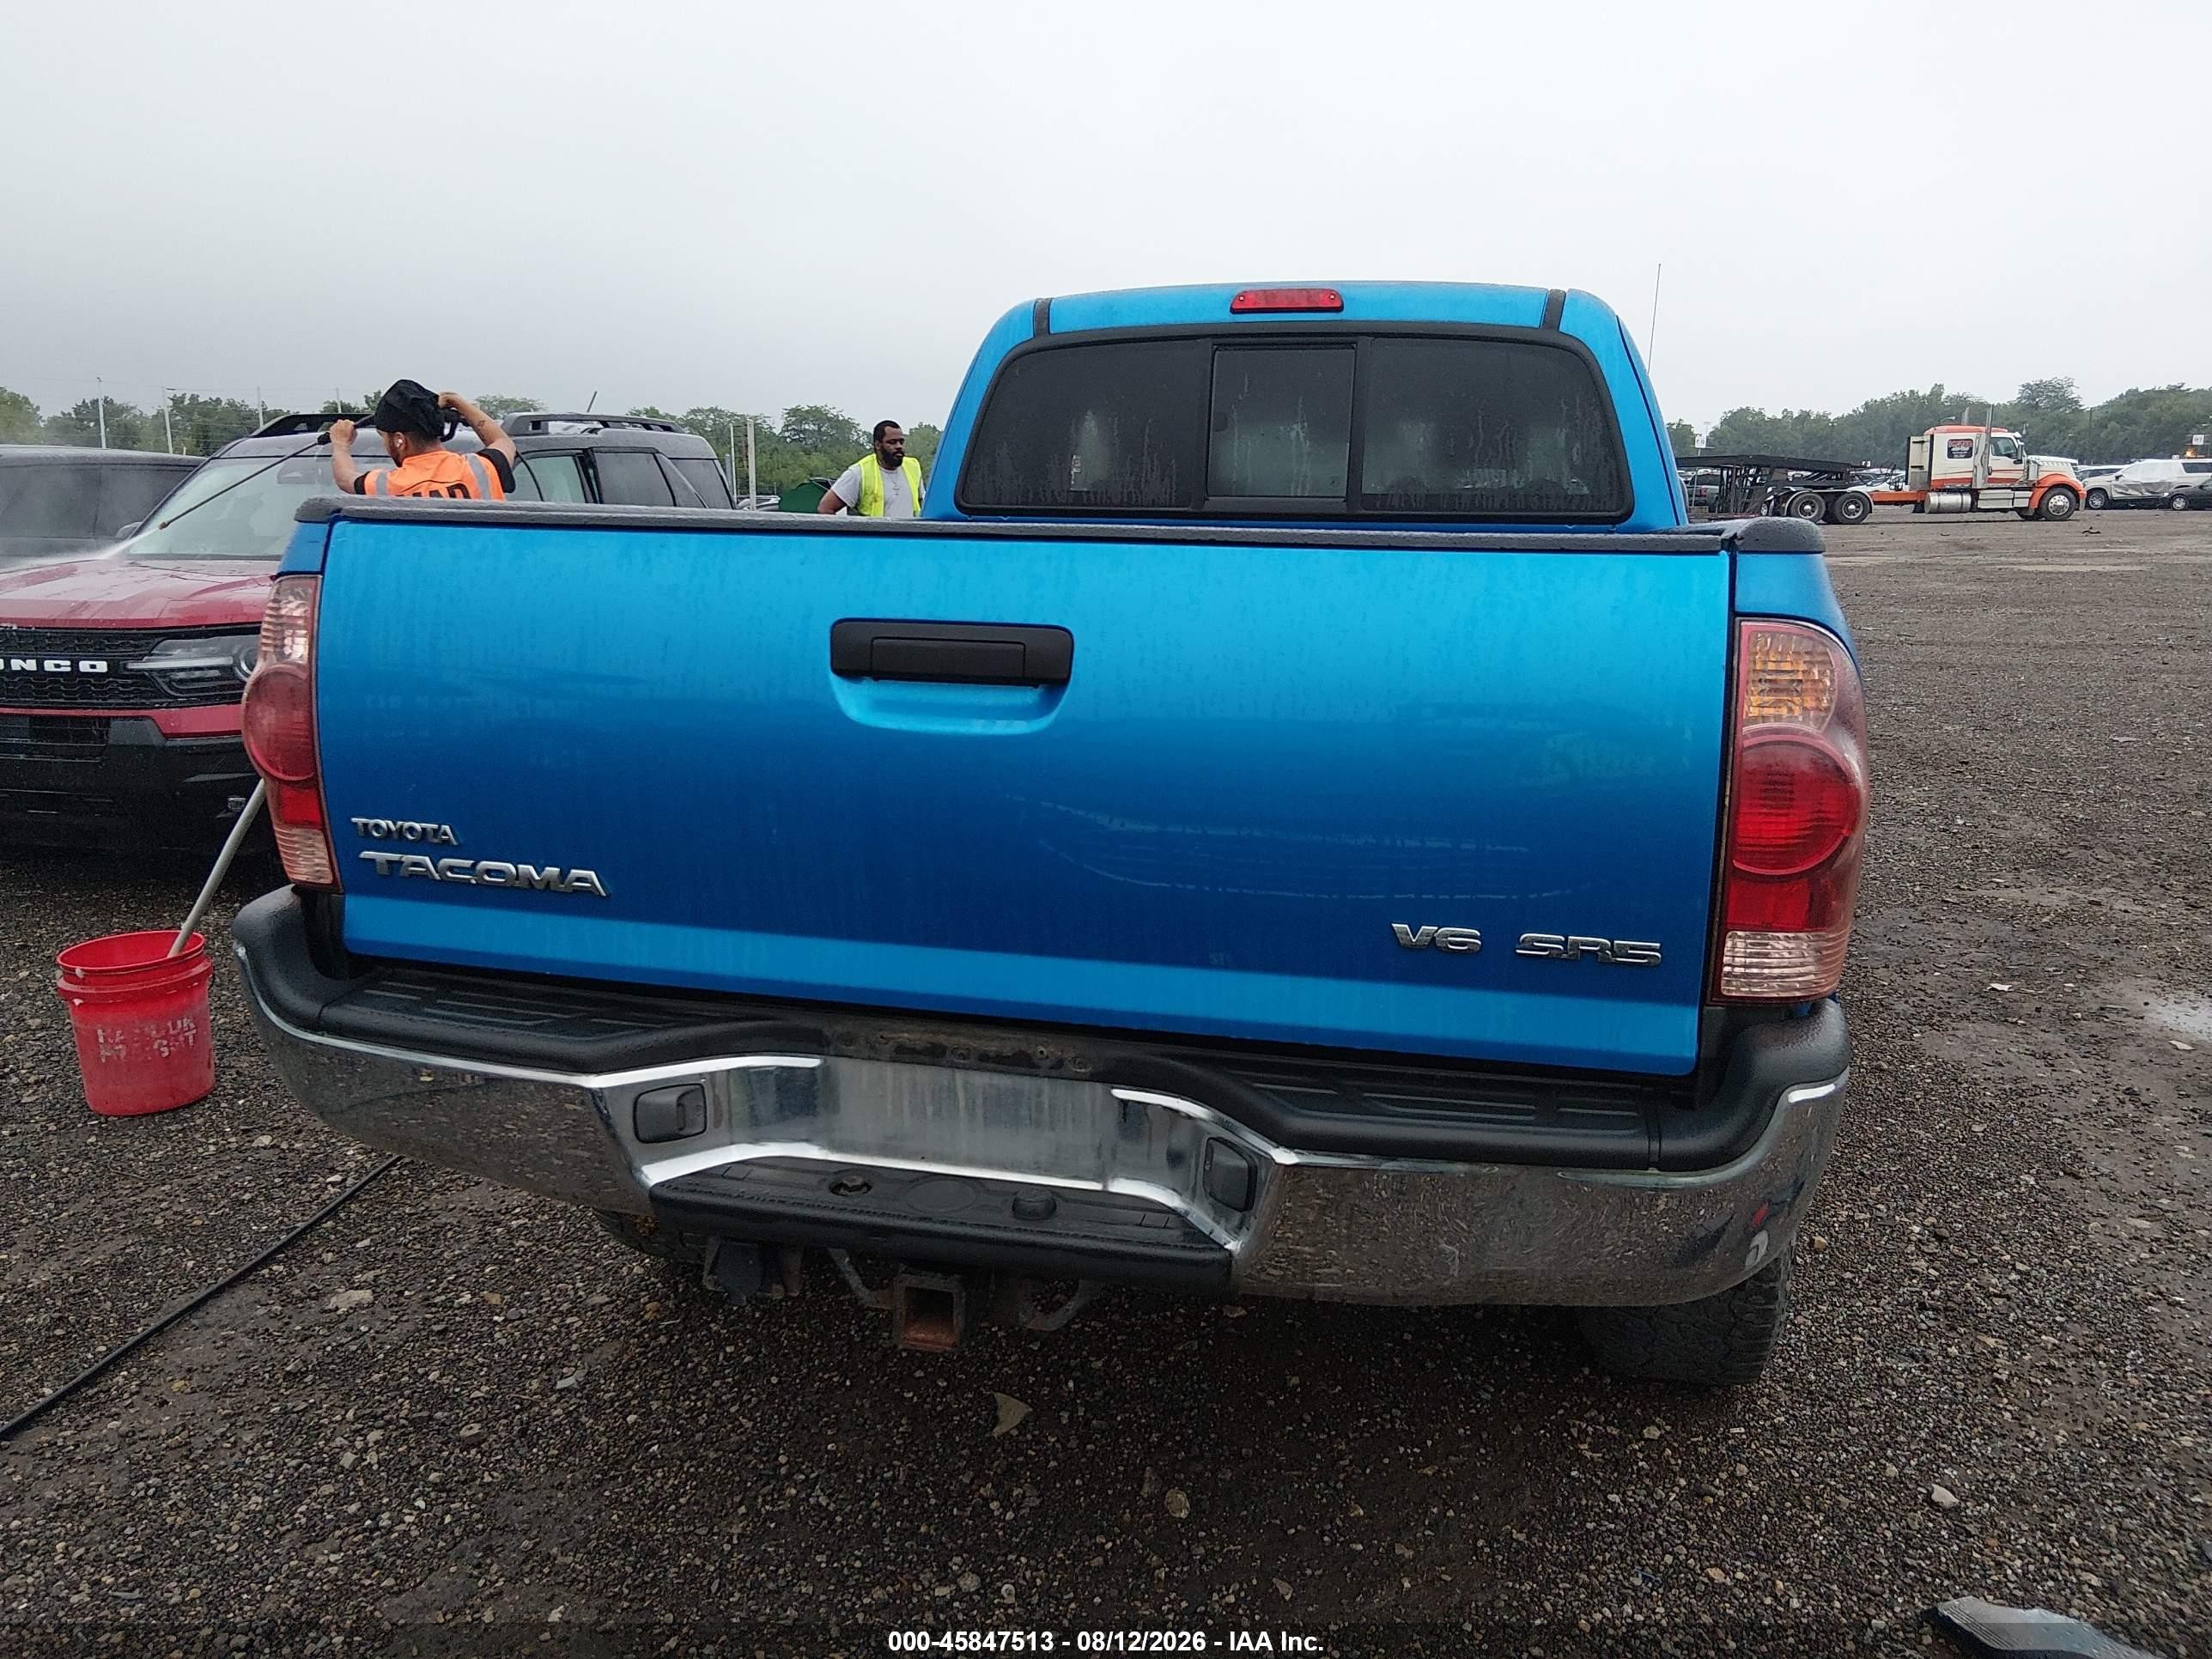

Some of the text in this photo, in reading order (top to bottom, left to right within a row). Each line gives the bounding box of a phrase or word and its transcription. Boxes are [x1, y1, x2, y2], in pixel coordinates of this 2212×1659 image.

[0, 658, 108, 673] NCO
[350, 817, 459, 846] TOYOTA
[358, 851, 608, 897] TACOMA
[1391, 922, 1662, 967] V6 SR5
